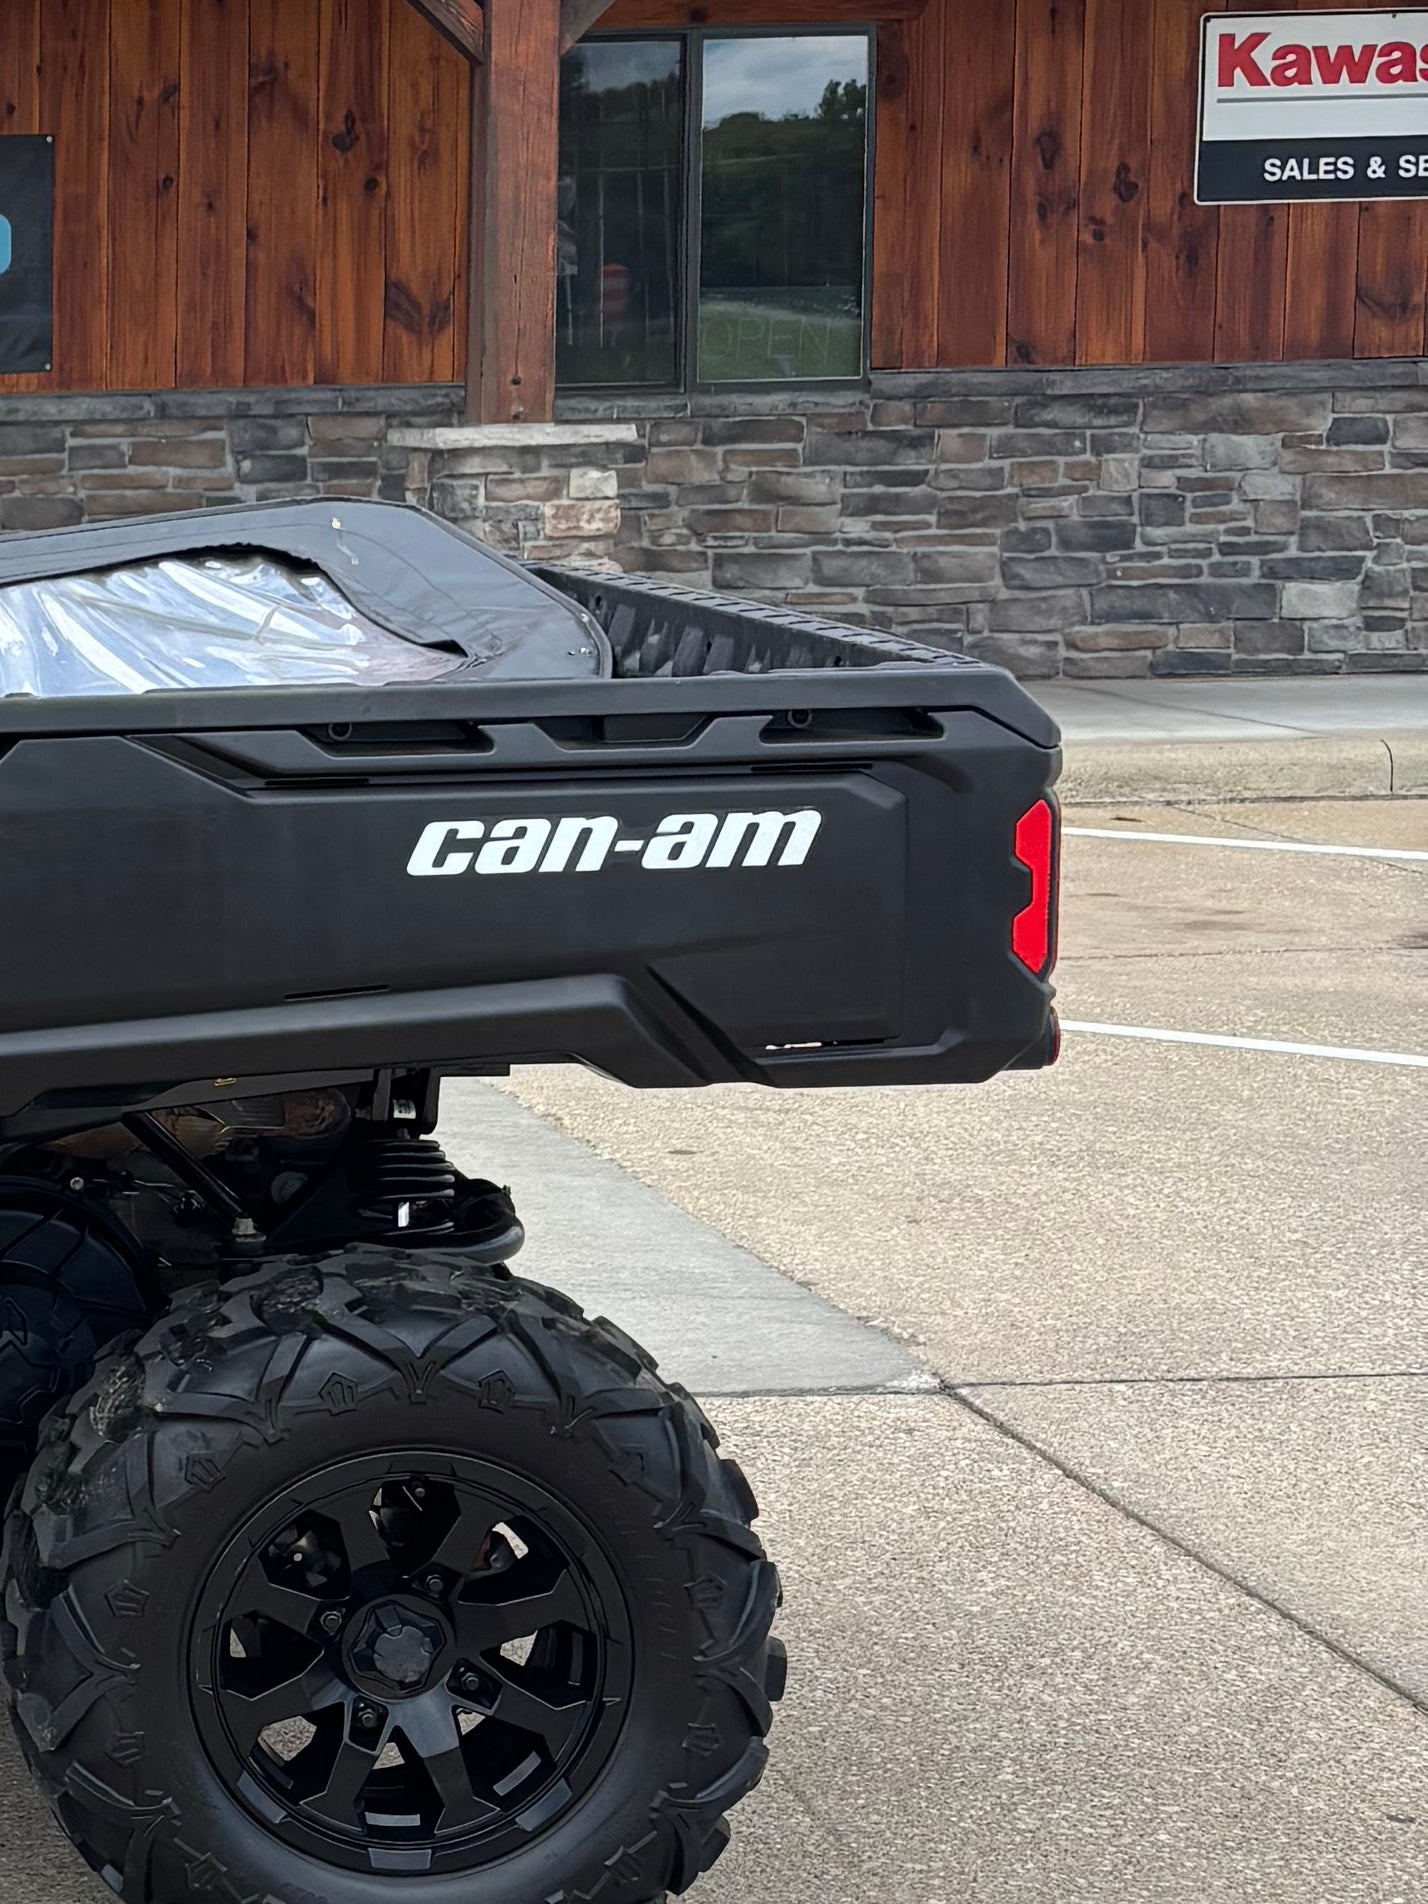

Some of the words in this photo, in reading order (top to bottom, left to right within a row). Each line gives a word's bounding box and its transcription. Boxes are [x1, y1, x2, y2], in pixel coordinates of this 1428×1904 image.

[1263, 157, 1355, 182] SALES
[1366, 156, 1386, 179] &
[406, 808, 824, 878] can-am
